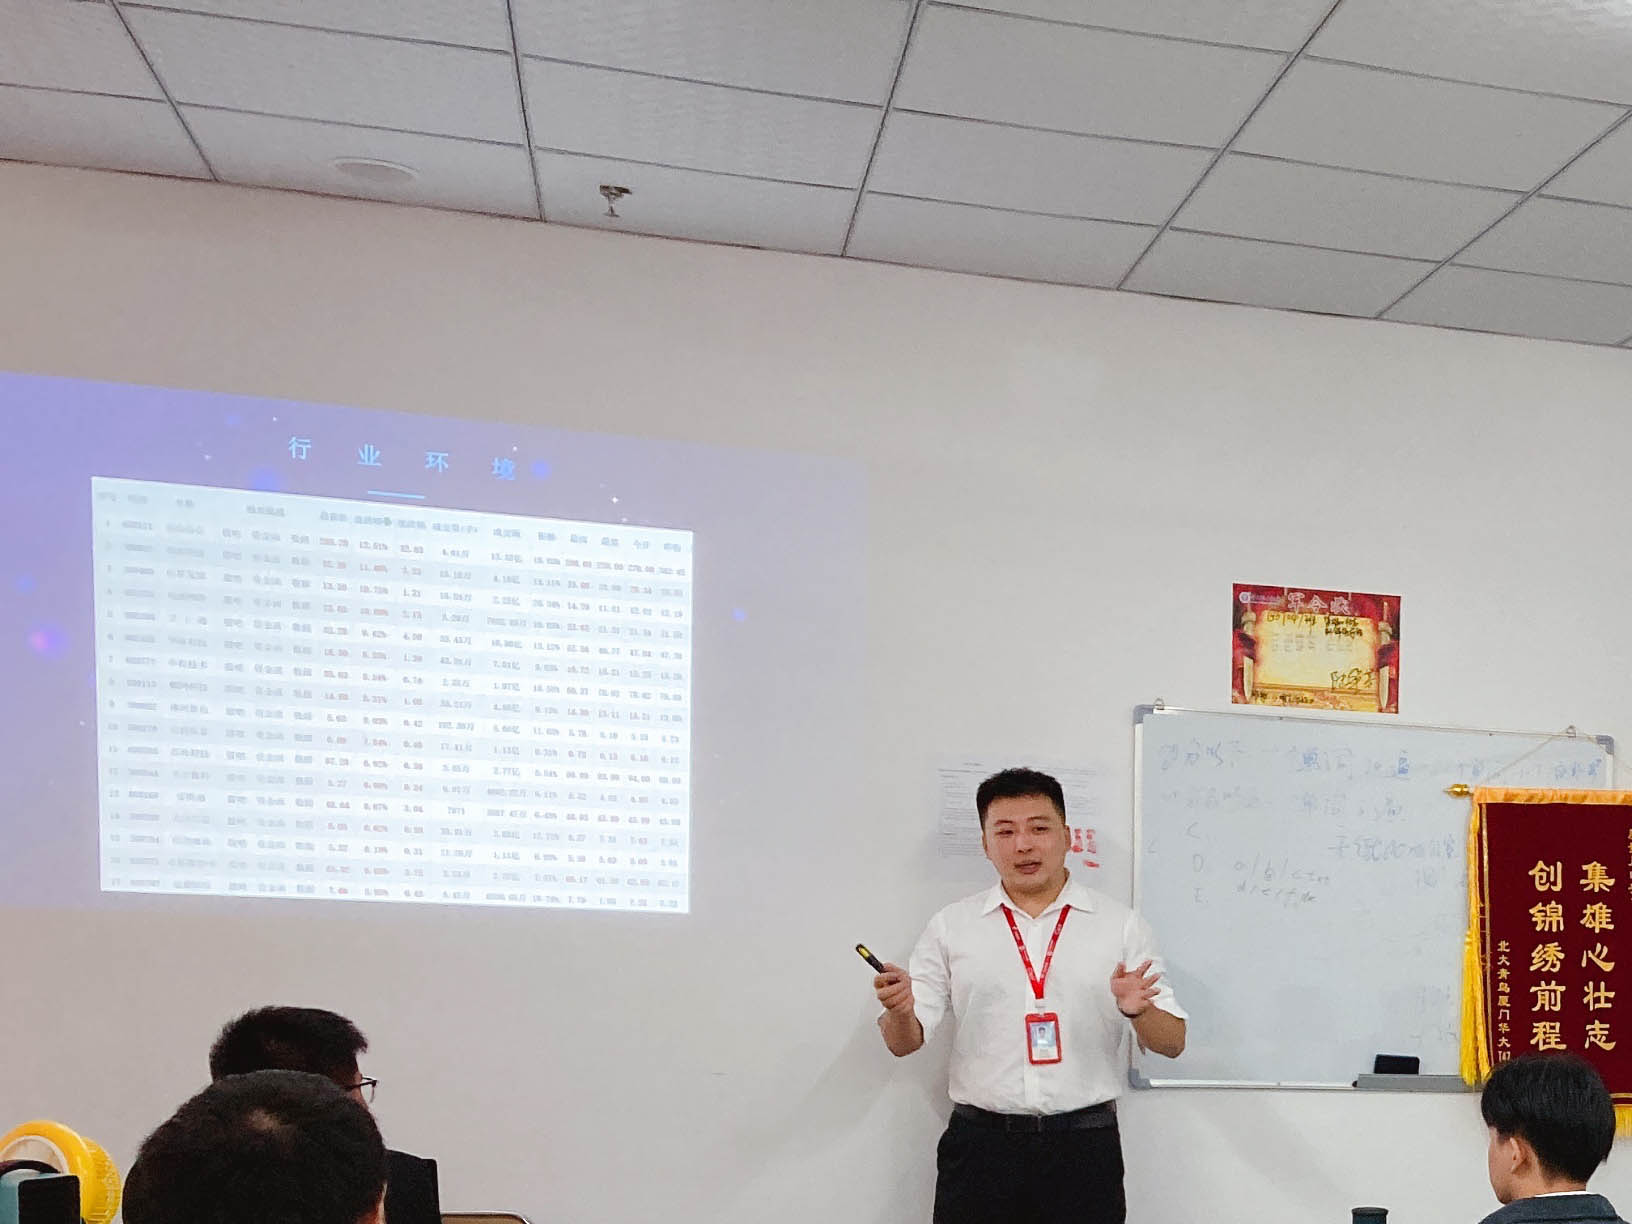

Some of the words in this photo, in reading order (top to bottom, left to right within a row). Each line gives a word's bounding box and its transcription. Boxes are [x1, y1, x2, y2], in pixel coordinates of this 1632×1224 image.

[1528, 860, 1567, 1051] 创锦绣前程
[1579, 860, 1616, 1051] 集雄心壮志
